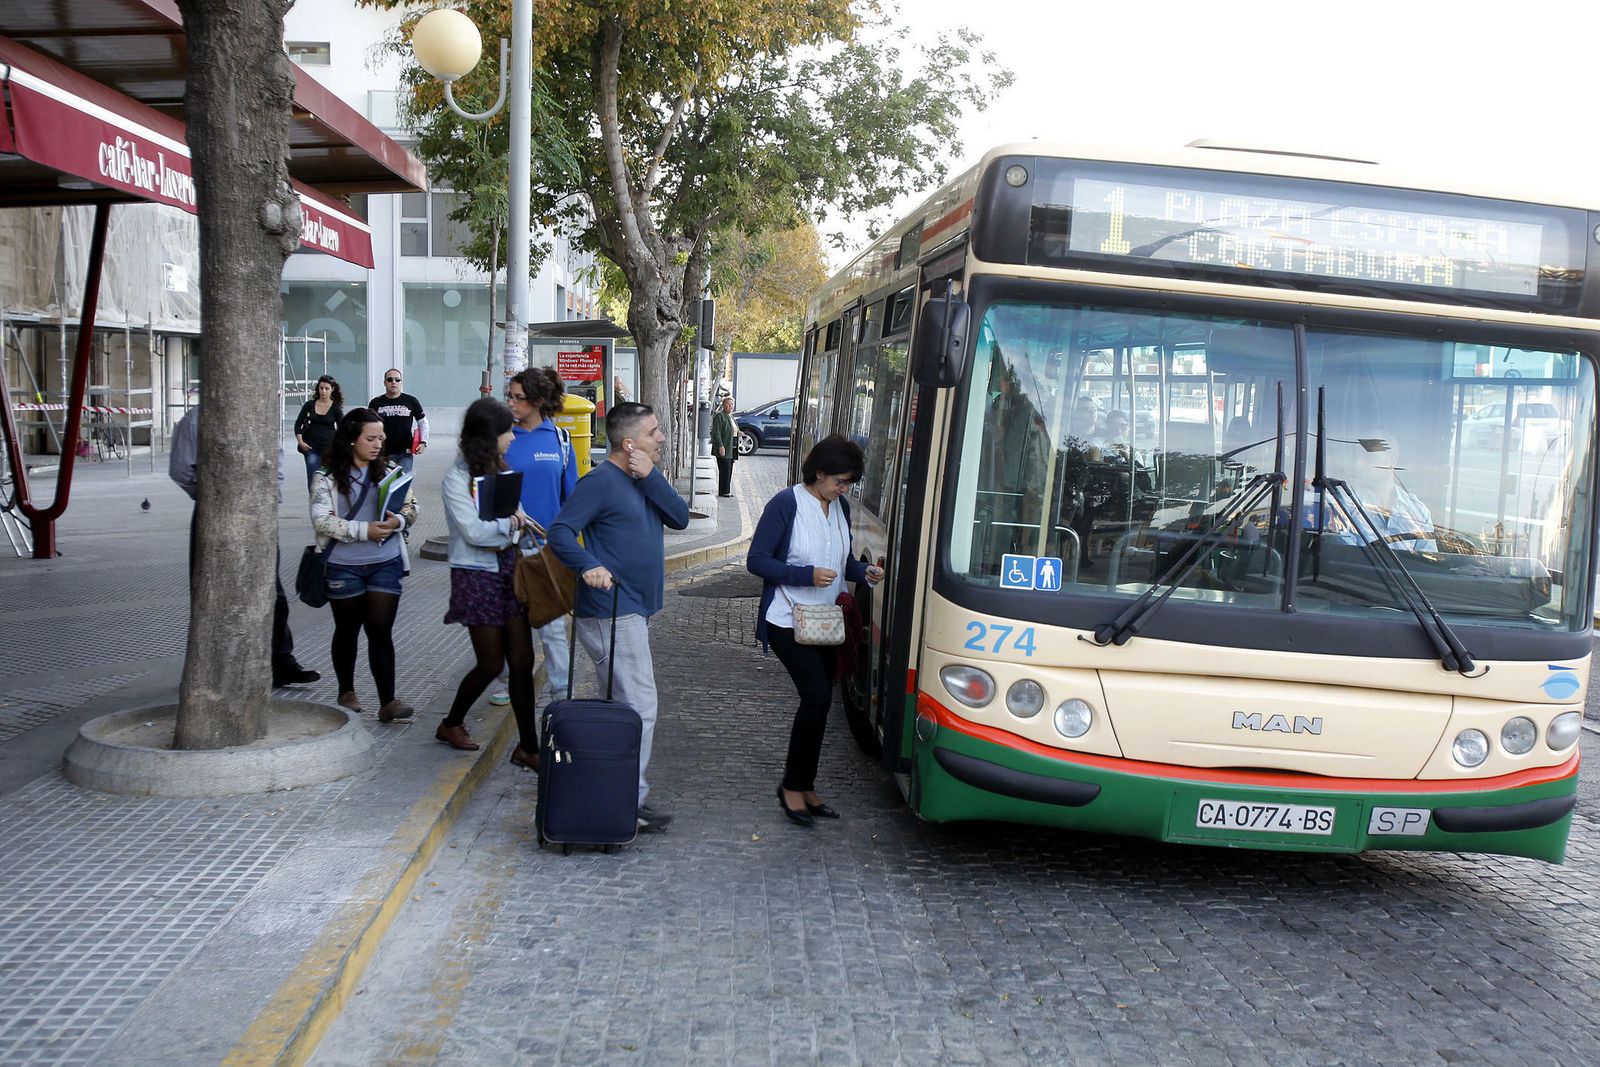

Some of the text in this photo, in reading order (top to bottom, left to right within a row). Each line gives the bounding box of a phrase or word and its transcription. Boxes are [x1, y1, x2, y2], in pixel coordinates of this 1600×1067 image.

[1100, 187, 1131, 255] 1
[964, 620, 1038, 657] 274
[1232, 711, 1323, 735] MAN
